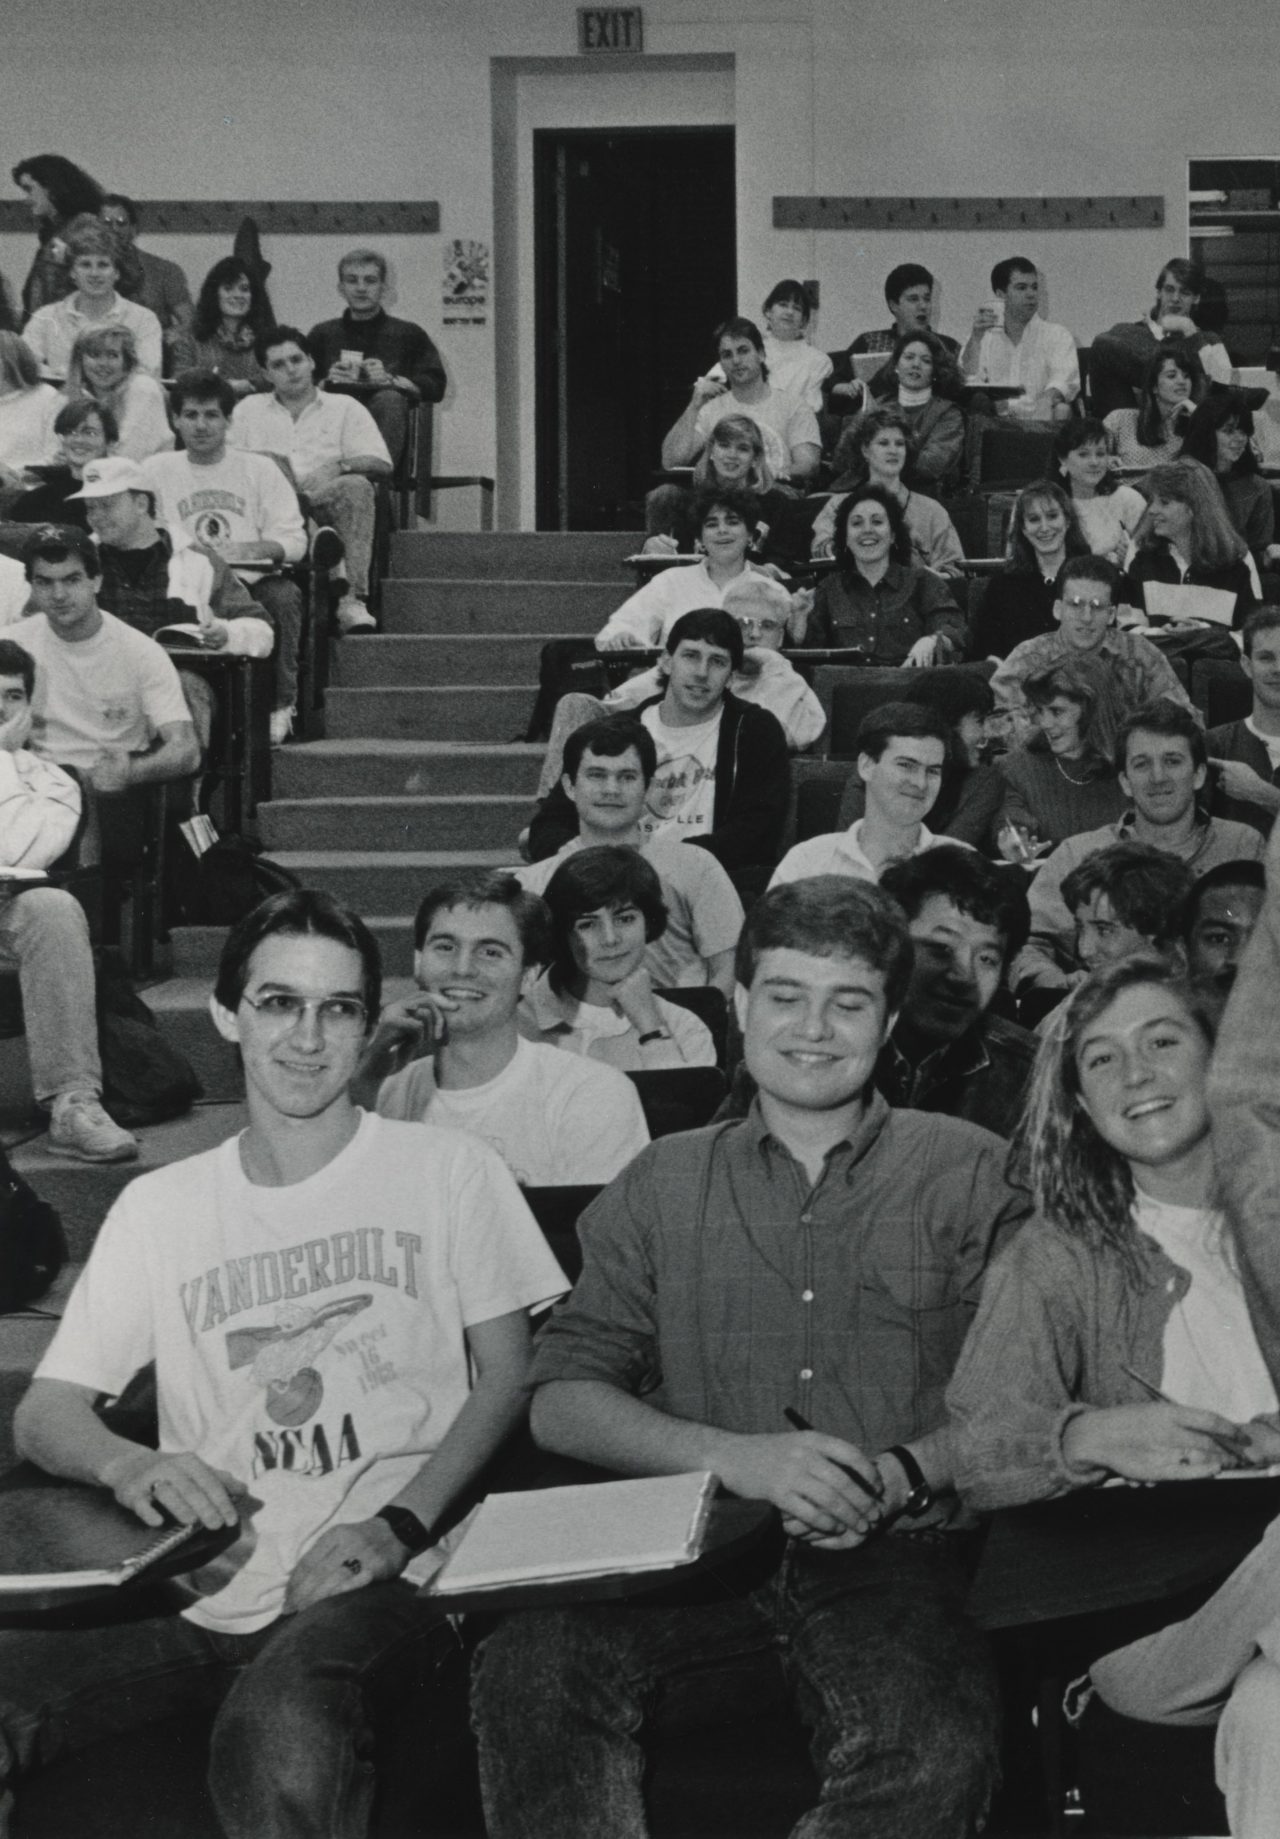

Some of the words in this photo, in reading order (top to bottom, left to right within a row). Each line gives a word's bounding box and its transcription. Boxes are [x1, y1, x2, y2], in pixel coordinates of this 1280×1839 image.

[583, 11, 634, 48] EXIT
[442, 295, 486, 307] europe
[179, 1227, 422, 1347] VANDERBILT
[251, 1412, 361, 1480] NCAA
